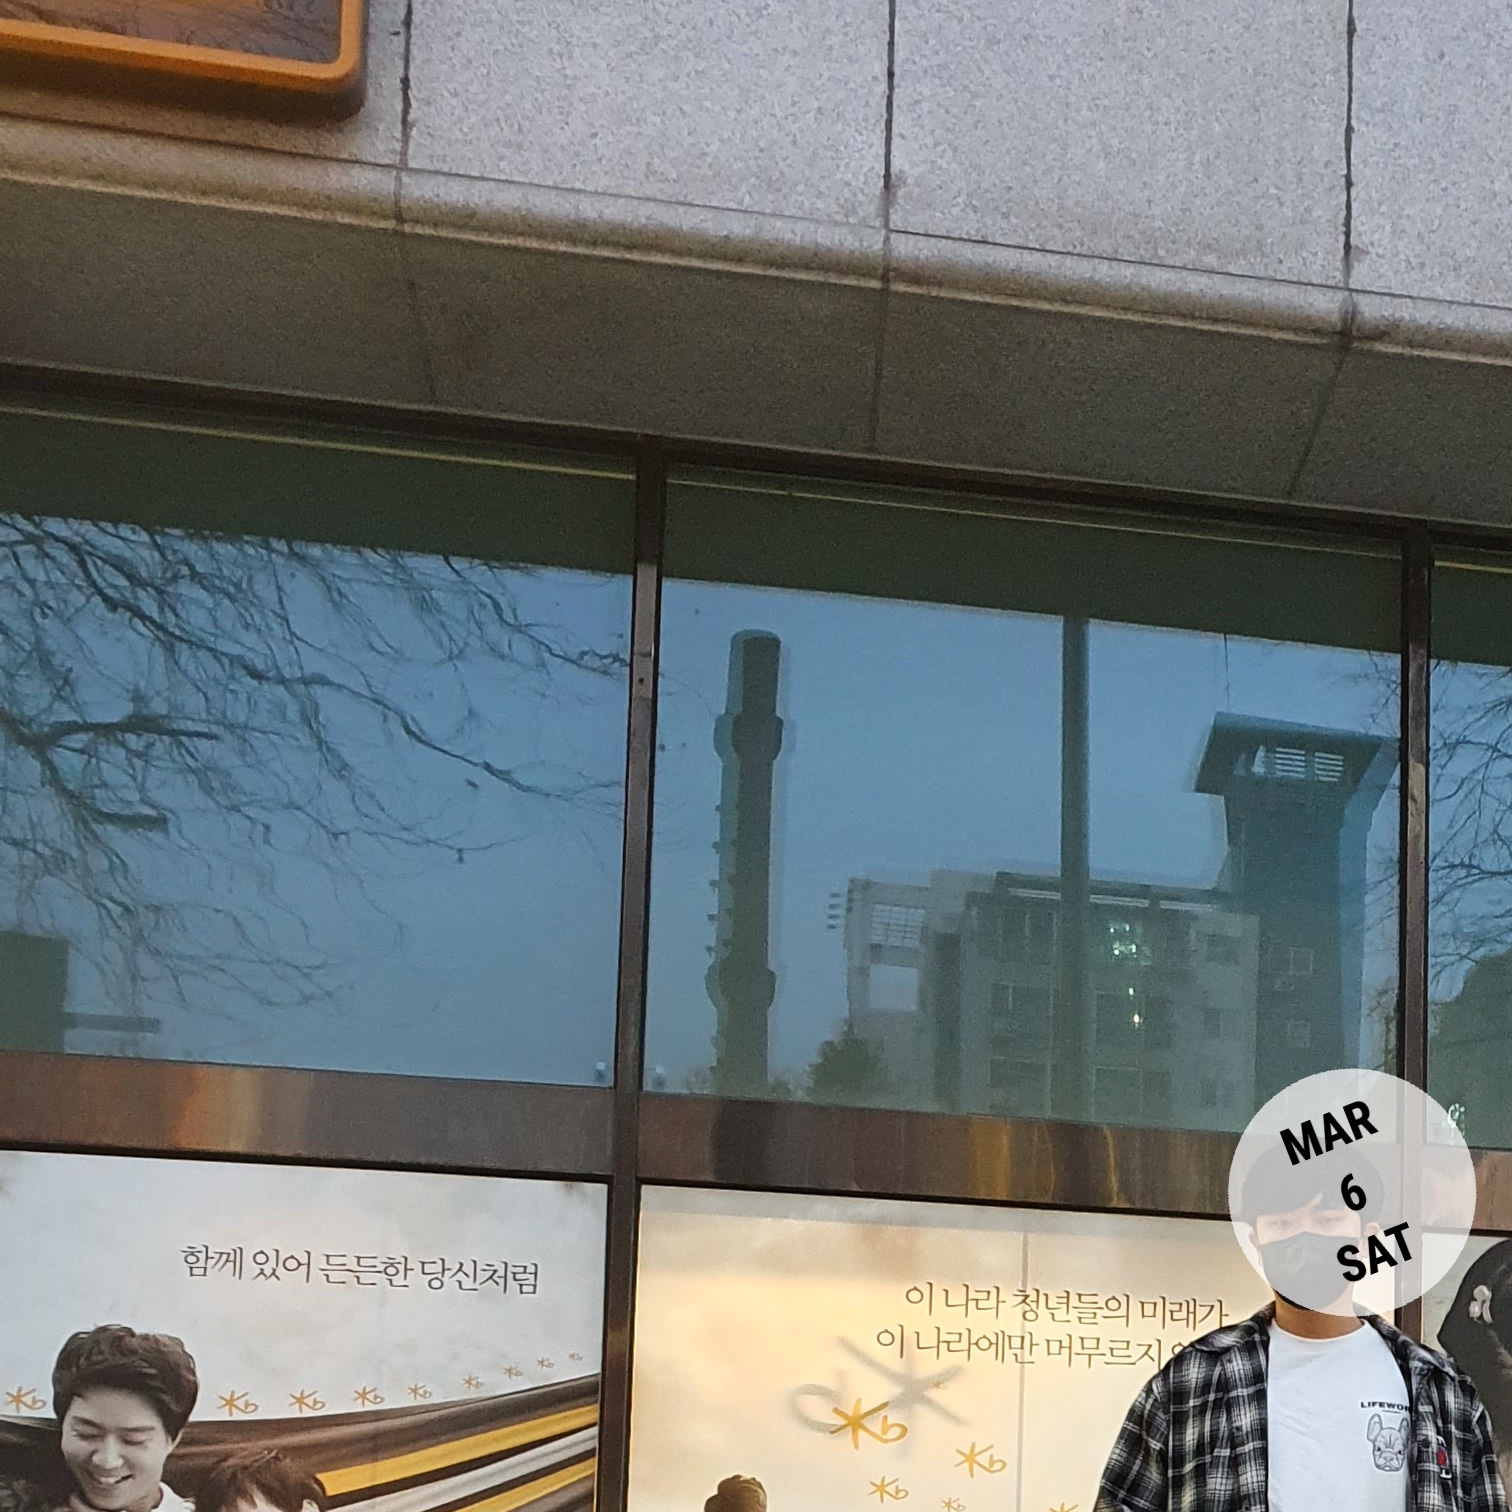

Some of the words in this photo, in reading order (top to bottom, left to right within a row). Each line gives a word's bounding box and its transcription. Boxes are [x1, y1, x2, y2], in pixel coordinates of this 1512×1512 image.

[181, 1244, 244, 1280] 함께
[252, 1249, 312, 1284] 있어
[318, 1253, 414, 1288] 든든한
[419, 1258, 540, 1295] 당신처럼
[905, 1281, 934, 1316] 이
[942, 1283, 1006, 1319] 나라
[1011, 1287, 1131, 1328] 청년들의
[1139, 1295, 1230, 1332] 미래가
[876, 1324, 904, 1359] 이
[914, 1325, 1039, 1364] 나라에만
[1044, 1333, 1163, 1371] 머무르지
[1360, 1401, 1409, 1411] LIFEWO
